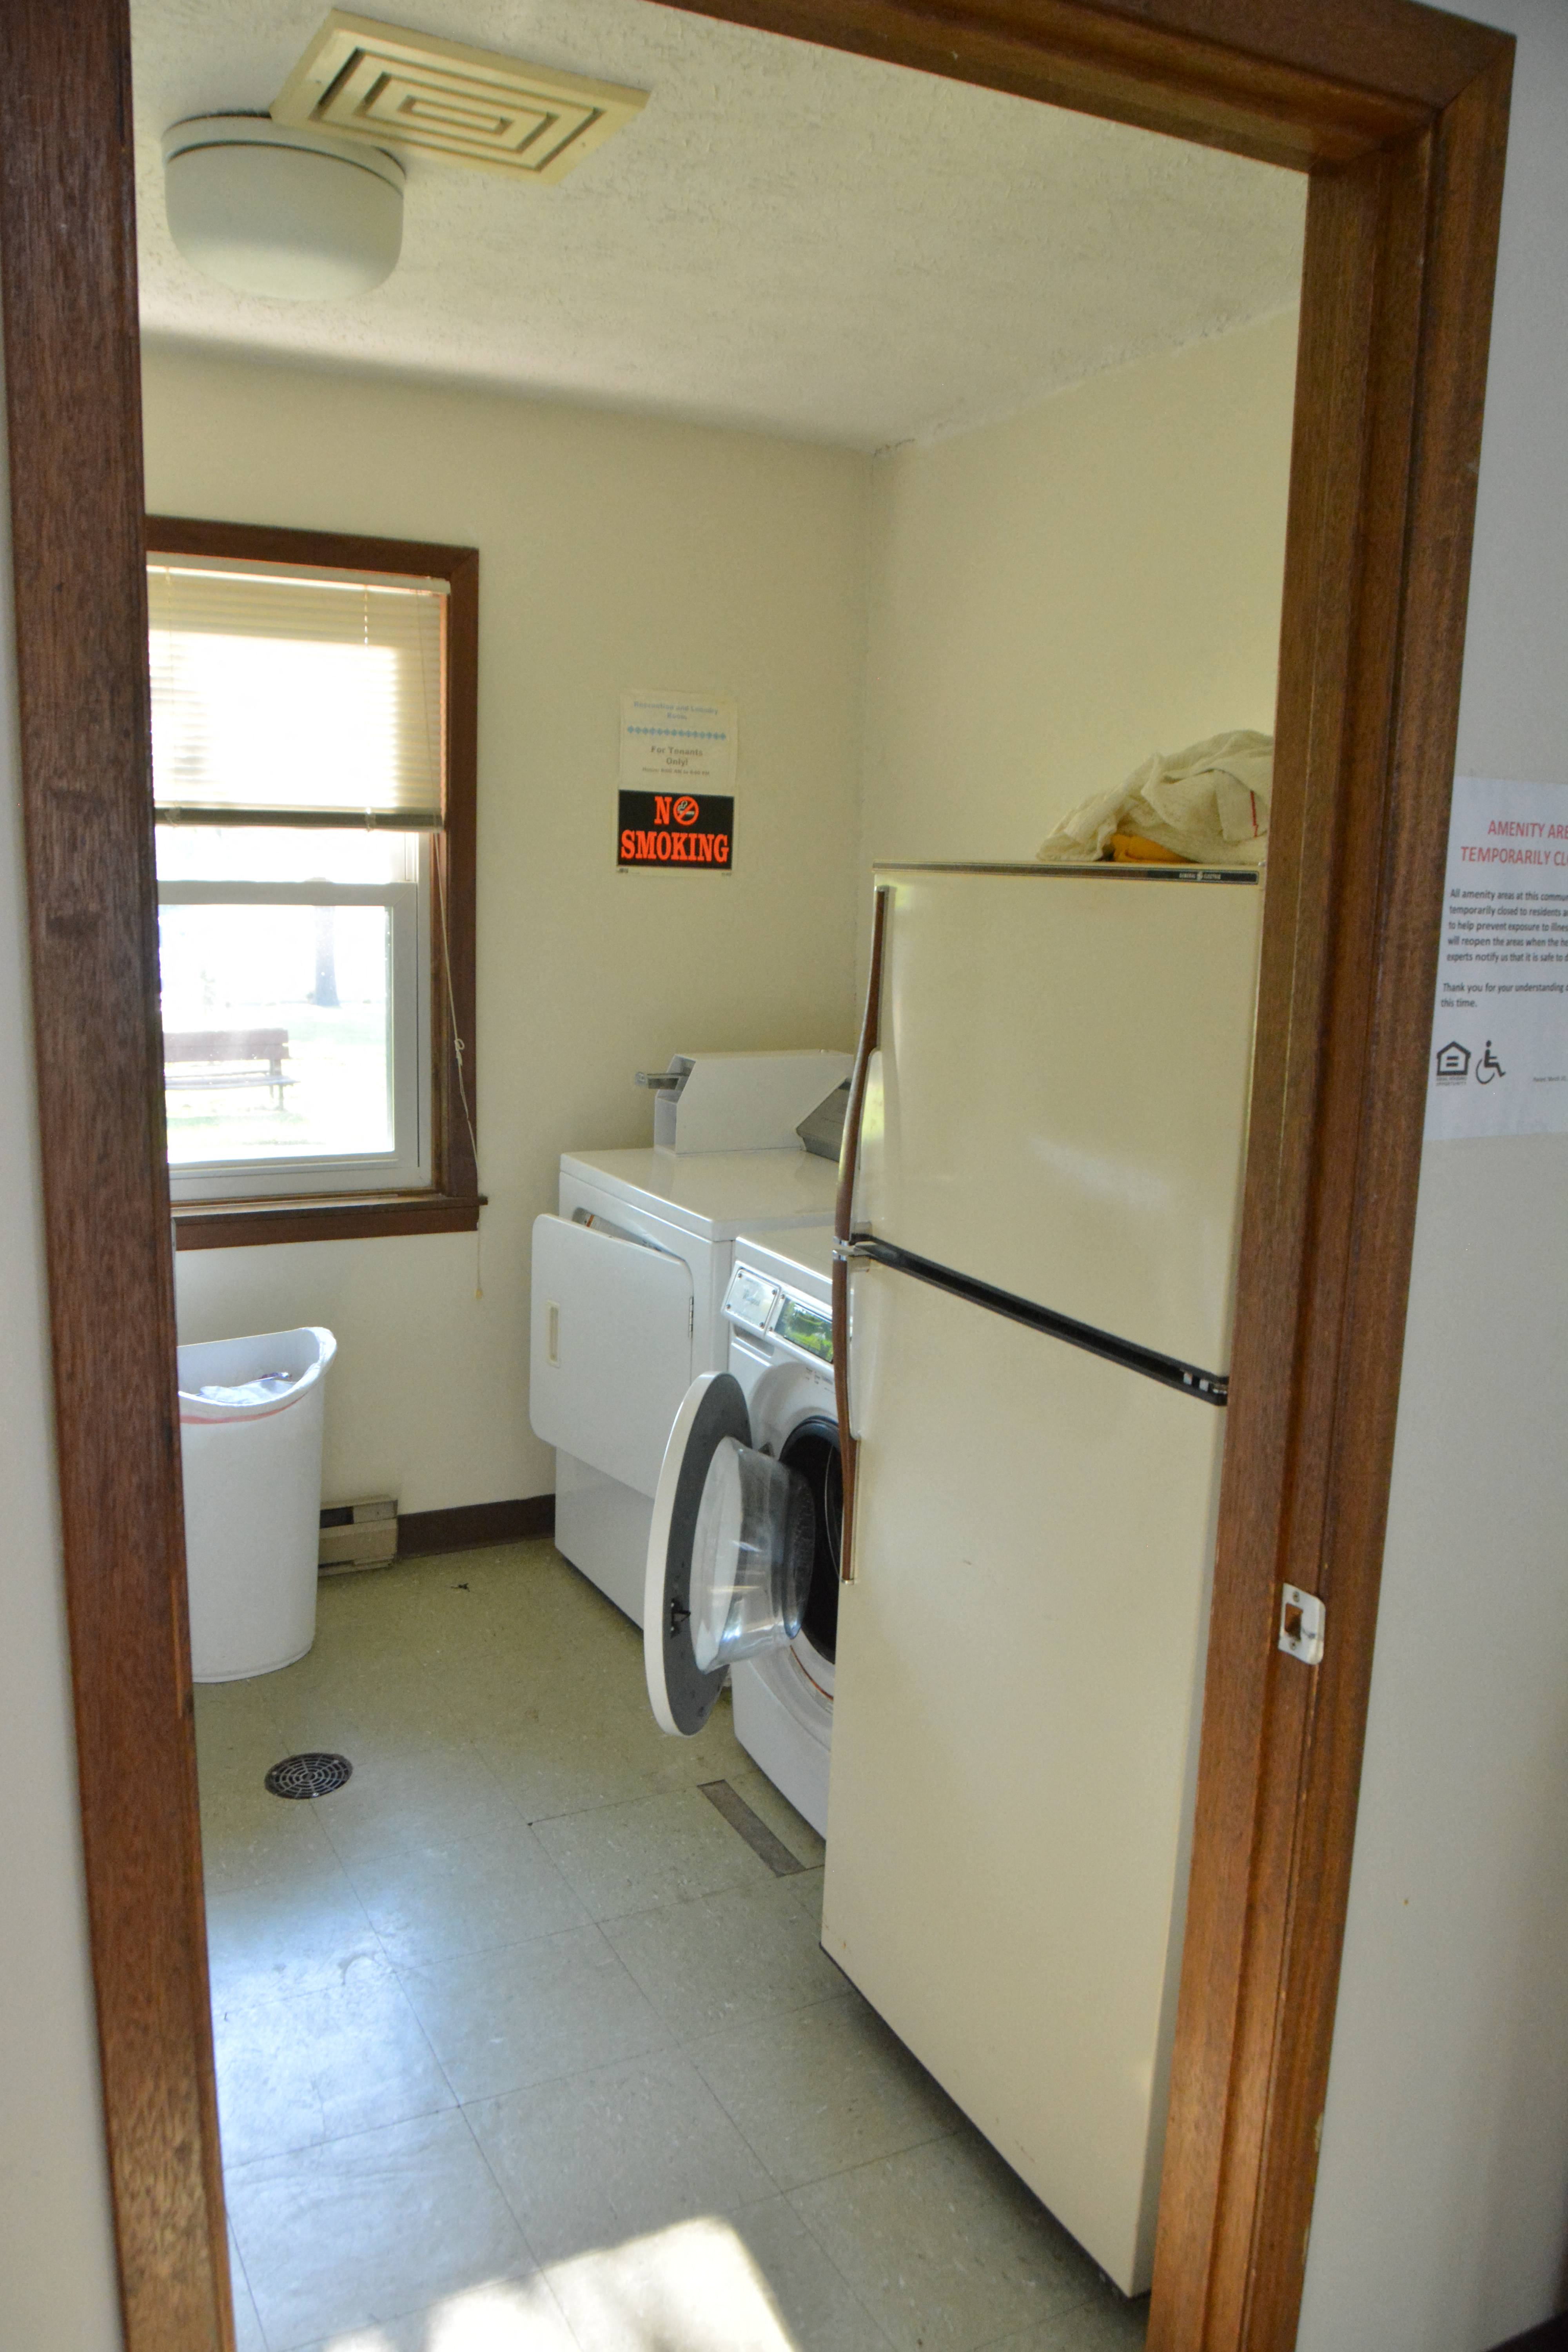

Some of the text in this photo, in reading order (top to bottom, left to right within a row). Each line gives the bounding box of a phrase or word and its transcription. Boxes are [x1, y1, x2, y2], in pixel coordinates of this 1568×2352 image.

[668, 746, 703, 756] Tenants
[666, 757, 688, 767] Only!
[1488, 820, 1545, 837] AMENITY
[621, 829, 729, 862] SMOKING
[1461, 846, 1568, 866] TEMPORARILY CL
[1451, 889, 1460, 898] All
[1462, 890, 1495, 901] amenity
[1497, 892, 1514, 900] areas
[1516, 892, 1523, 900] at
[1525, 891, 1538, 900] this
[1449, 905, 1495, 916] temporarily
[1497, 906, 1518, 916] closed
[1529, 907, 1561, 916] residents
[1449, 921, 1455, 929] to
[1458, 921, 1474, 931] help
[1476, 922, 1506, 931] prevent
[1508, 923, 1540, 933] exposure
[1448, 936, 1459, 945] will
[1462, 937, 1490, 947] reopen
[1493, 936, 1504, 946] the
[1526, 937, 1545, 946] when
[1548, 937, 1559, 946] the
[1447, 953, 1472, 962] experts
[1475, 952, 1499, 963] notify
[1510, 953, 1524, 961] that
[1533, 953, 1538, 961] is
[1541, 953, 1554, 961] safe
[1443, 983, 1465, 992] Thank
[1468, 984, 1483, 994] you
[1485, 983, 1496, 992] for
[1498, 984, 1514, 994] your
[1515, 982, 1564, 993] understanding
[1441, 998, 1477, 1008] this time.
